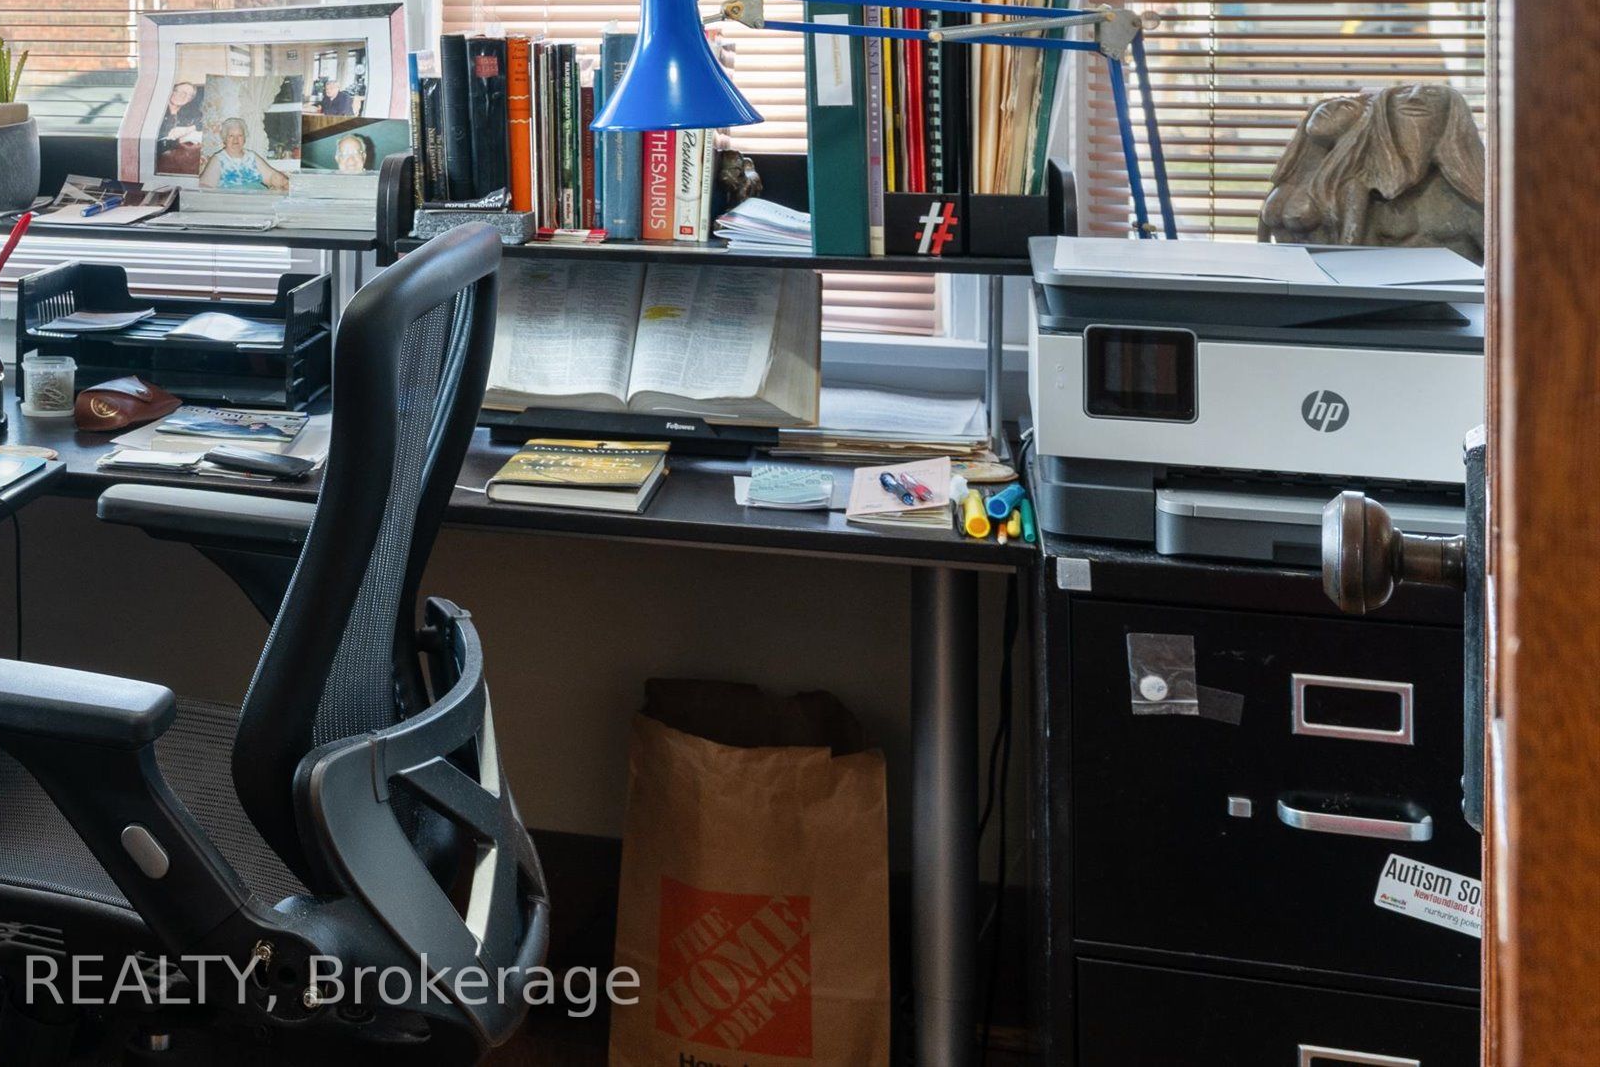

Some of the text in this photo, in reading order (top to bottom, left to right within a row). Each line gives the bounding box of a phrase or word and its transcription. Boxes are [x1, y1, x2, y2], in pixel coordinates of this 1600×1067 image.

[650, 130, 668, 231] THESAURUS
[680, 129, 698, 194] Resolution
[1307, 390, 1345, 432] hp
[1385, 858, 1452, 896] Autism
[1413, 888, 1468, 913] Newfoundland
[674, 906, 735, 964] THE
[1424, 907, 1459, 924] nurturing
[657, 894, 811, 1037] HOME
[714, 953, 811, 1049] DEPOT
